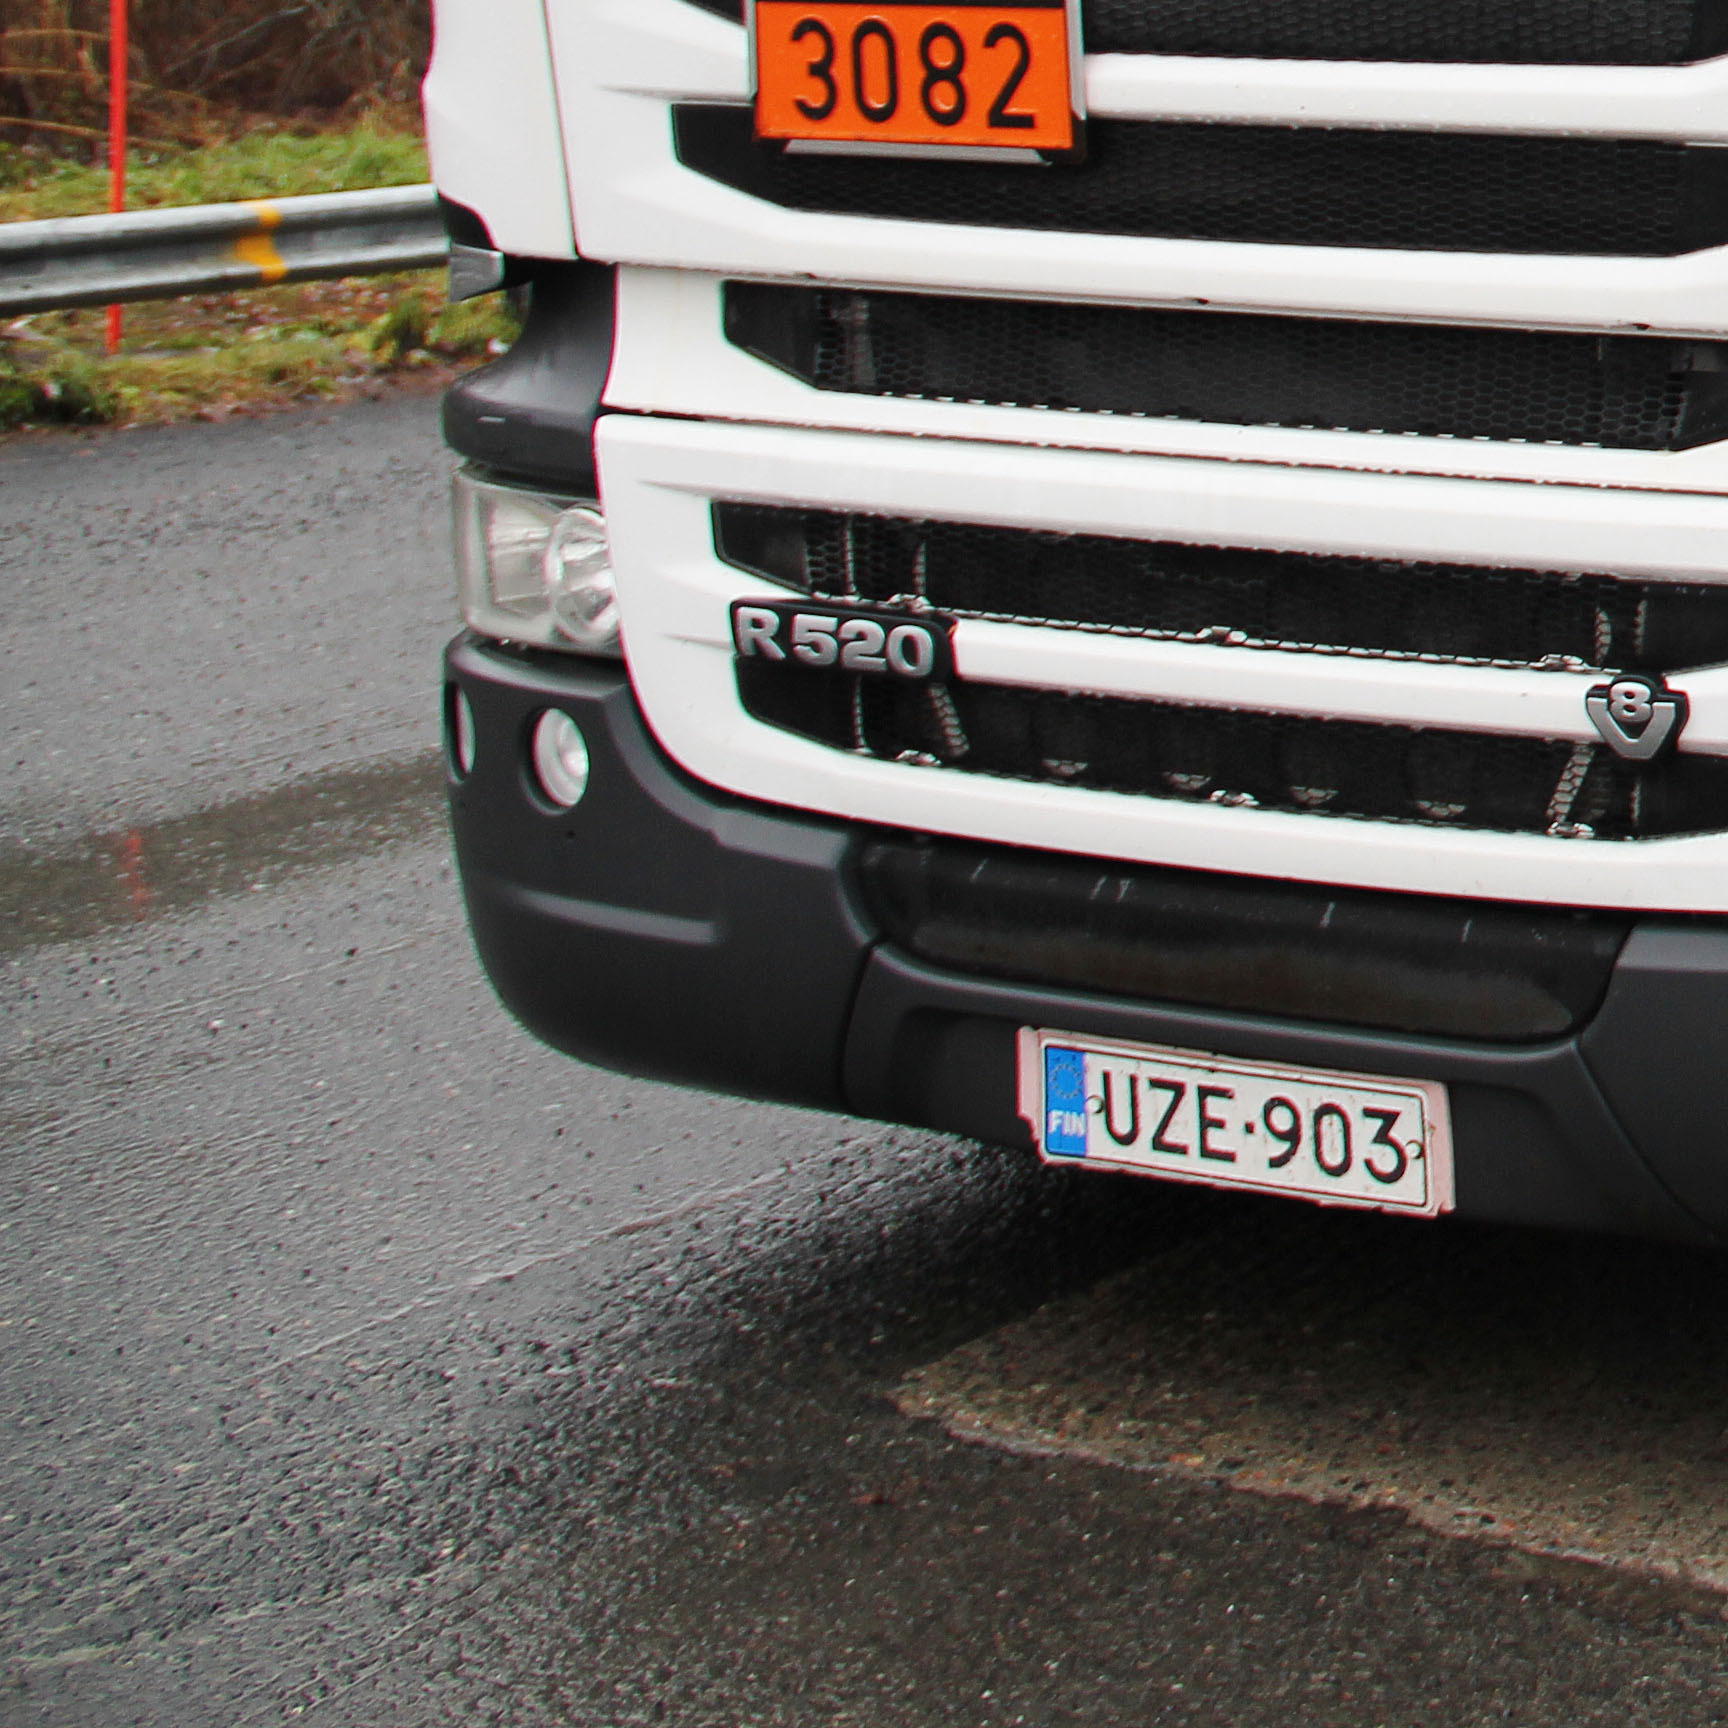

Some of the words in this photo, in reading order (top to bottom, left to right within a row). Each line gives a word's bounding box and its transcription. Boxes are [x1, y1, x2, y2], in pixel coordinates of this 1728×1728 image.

[790, 17, 1037, 129] 3082
[734, 605, 787, 661] R
[791, 613, 935, 677] 520
[1047, 1108, 1086, 1138] FIN
